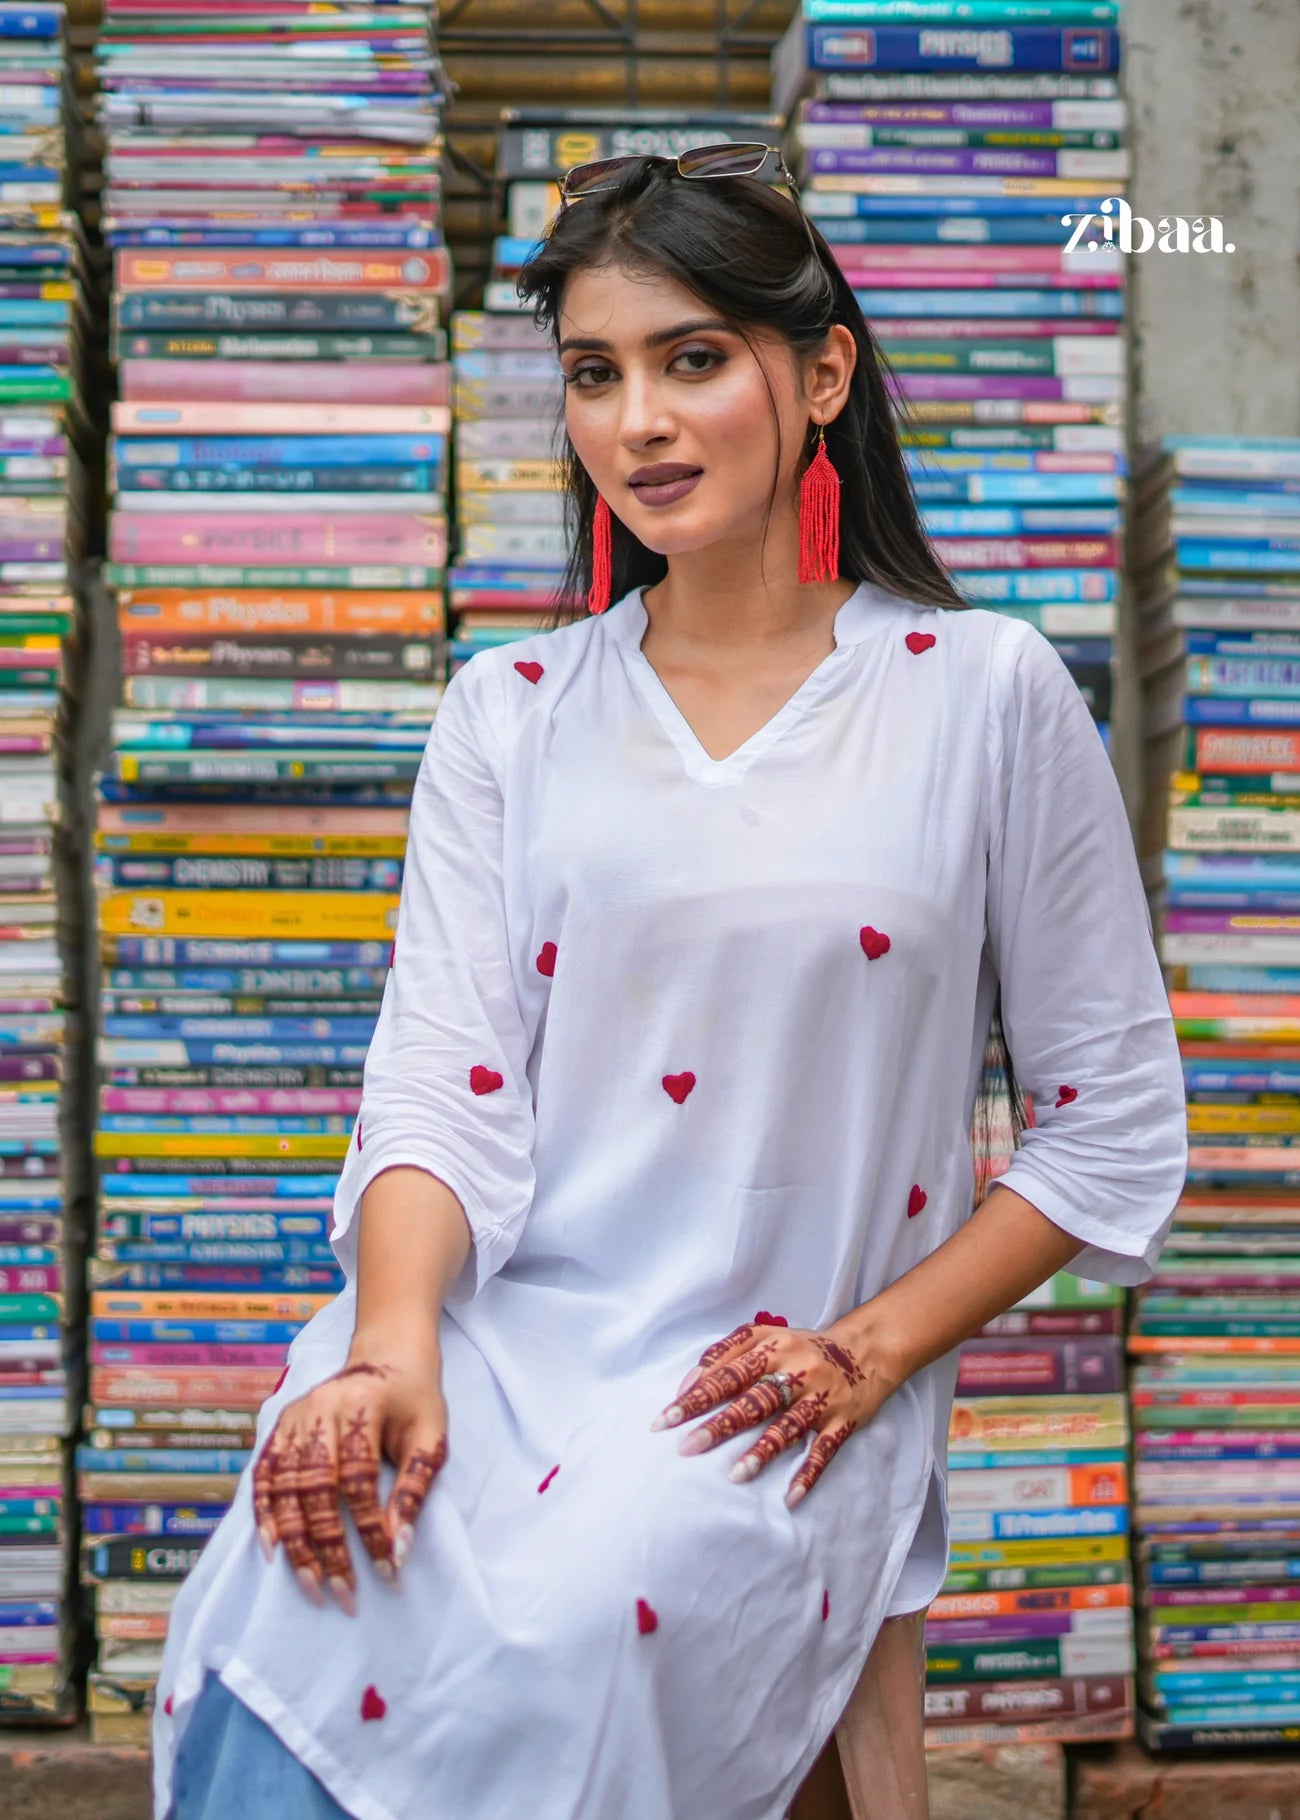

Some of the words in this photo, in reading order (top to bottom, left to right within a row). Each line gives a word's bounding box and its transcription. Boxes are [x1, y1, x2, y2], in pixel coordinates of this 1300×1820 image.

[918, 30, 1012, 58] PHYSICS
[204, 297, 287, 323] Physics
[210, 596, 310, 626] Physics
[211, 641, 294, 672] Physics
[174, 859, 270, 884] CHEMISTRY
[185, 942, 273, 961] SCIENCE
[239, 968, 343, 992] SCIENCE
[181, 1213, 277, 1239] PHYSICS
[187, 1242, 284, 1260] CHEMISTRY
[1015, 1591, 1071, 1609] NEET
[981, 1689, 1064, 1713] PHYSICS
